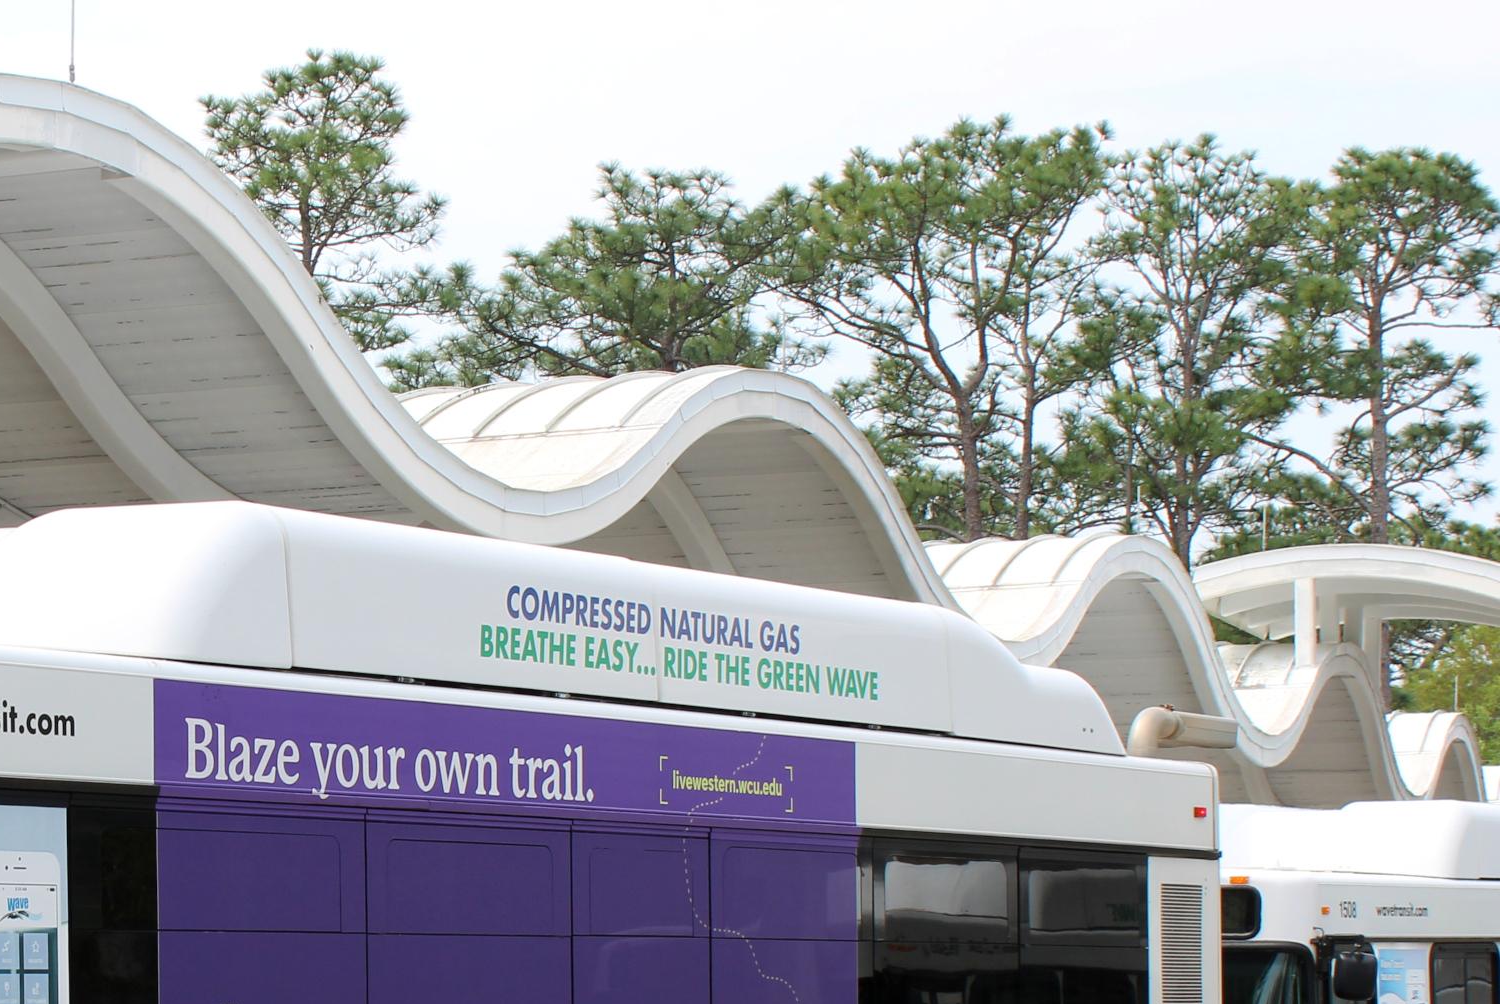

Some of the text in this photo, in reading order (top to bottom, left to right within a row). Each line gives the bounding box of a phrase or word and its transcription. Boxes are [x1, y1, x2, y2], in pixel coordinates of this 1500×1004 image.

[505, 585, 800, 655] COMPRESSED NATURAL GAS
[480, 625, 879, 700] BREATHE EASY... RIDE THE GREEN WAVE
[185, 717, 594, 802] Blaze your own trail.
[672, 769, 783, 797] livewestern.wcu.edu
[1339, 901, 1357, 918] 1508
[1376, 902, 1428, 917] wavetransit.com
